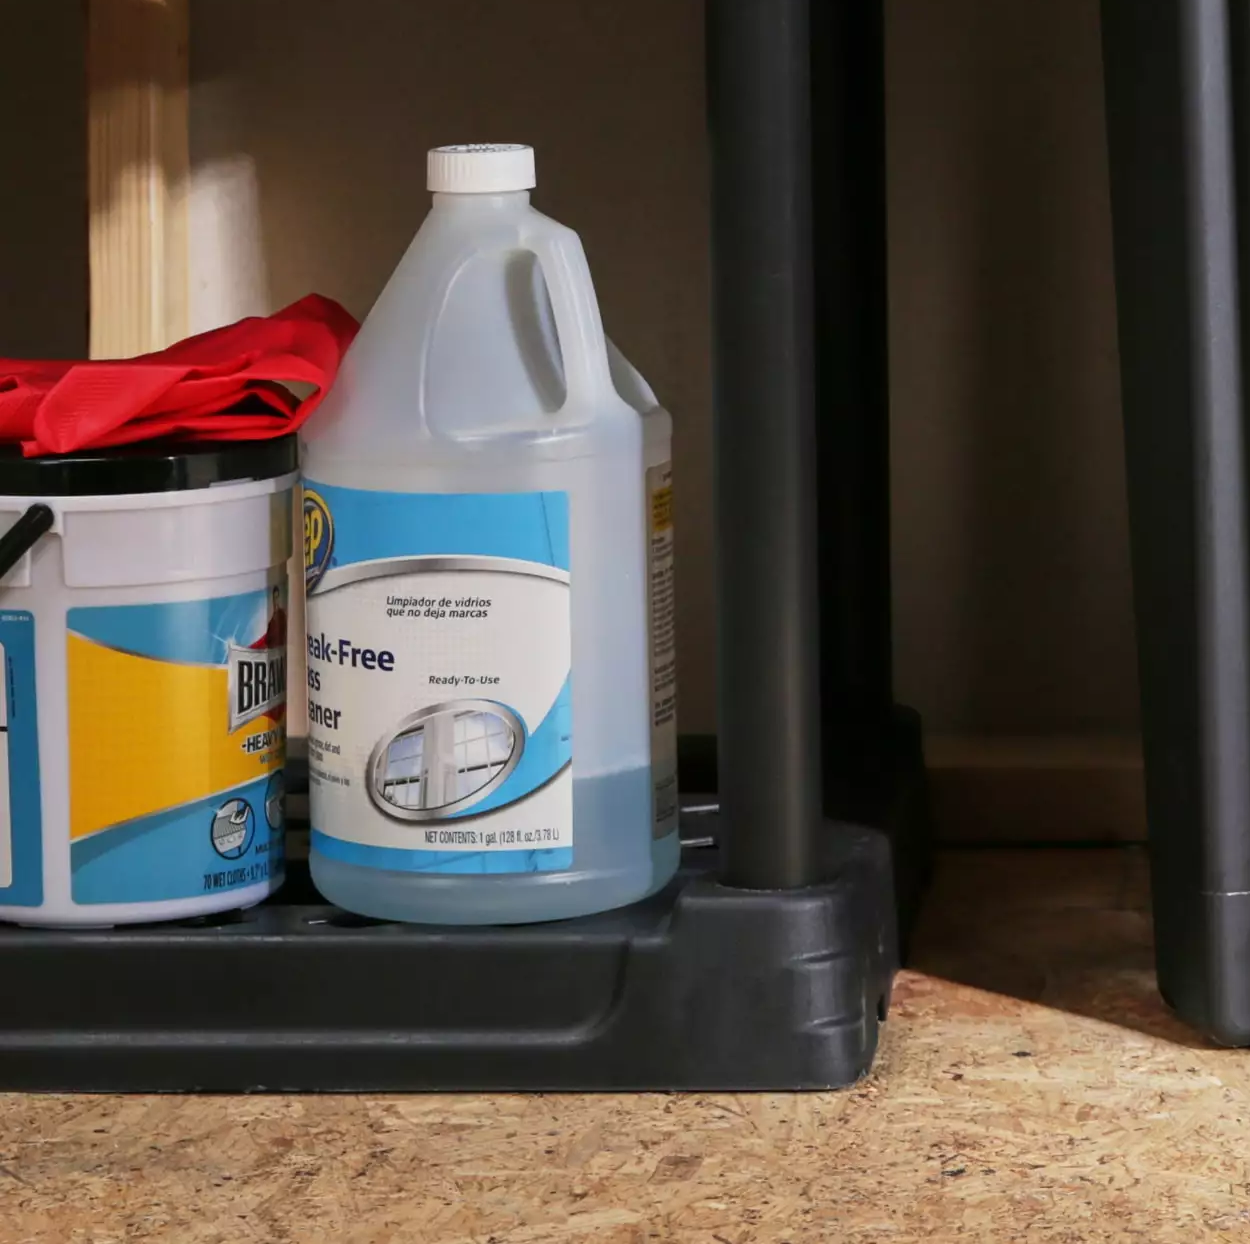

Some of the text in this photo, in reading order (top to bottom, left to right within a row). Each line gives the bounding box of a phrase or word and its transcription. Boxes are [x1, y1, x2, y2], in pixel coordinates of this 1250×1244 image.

[386, 596, 492, 608] Limpiador de vidrios
[386, 608, 488, 619] que no deja marcas
[307, 632, 395, 672] eak-Free
[237, 656, 287, 714] BRAW
[428, 675, 500, 686] Ready-To-Use
[308, 697, 342, 730] aner
[424, 830, 438, 844] NET
[440, 830, 478, 844] CONTENTS:
[480, 830, 484, 844] 1
[486, 832, 497, 846] gal.
[500, 830, 514, 845] (128
[204, 874, 212, 890] 70
